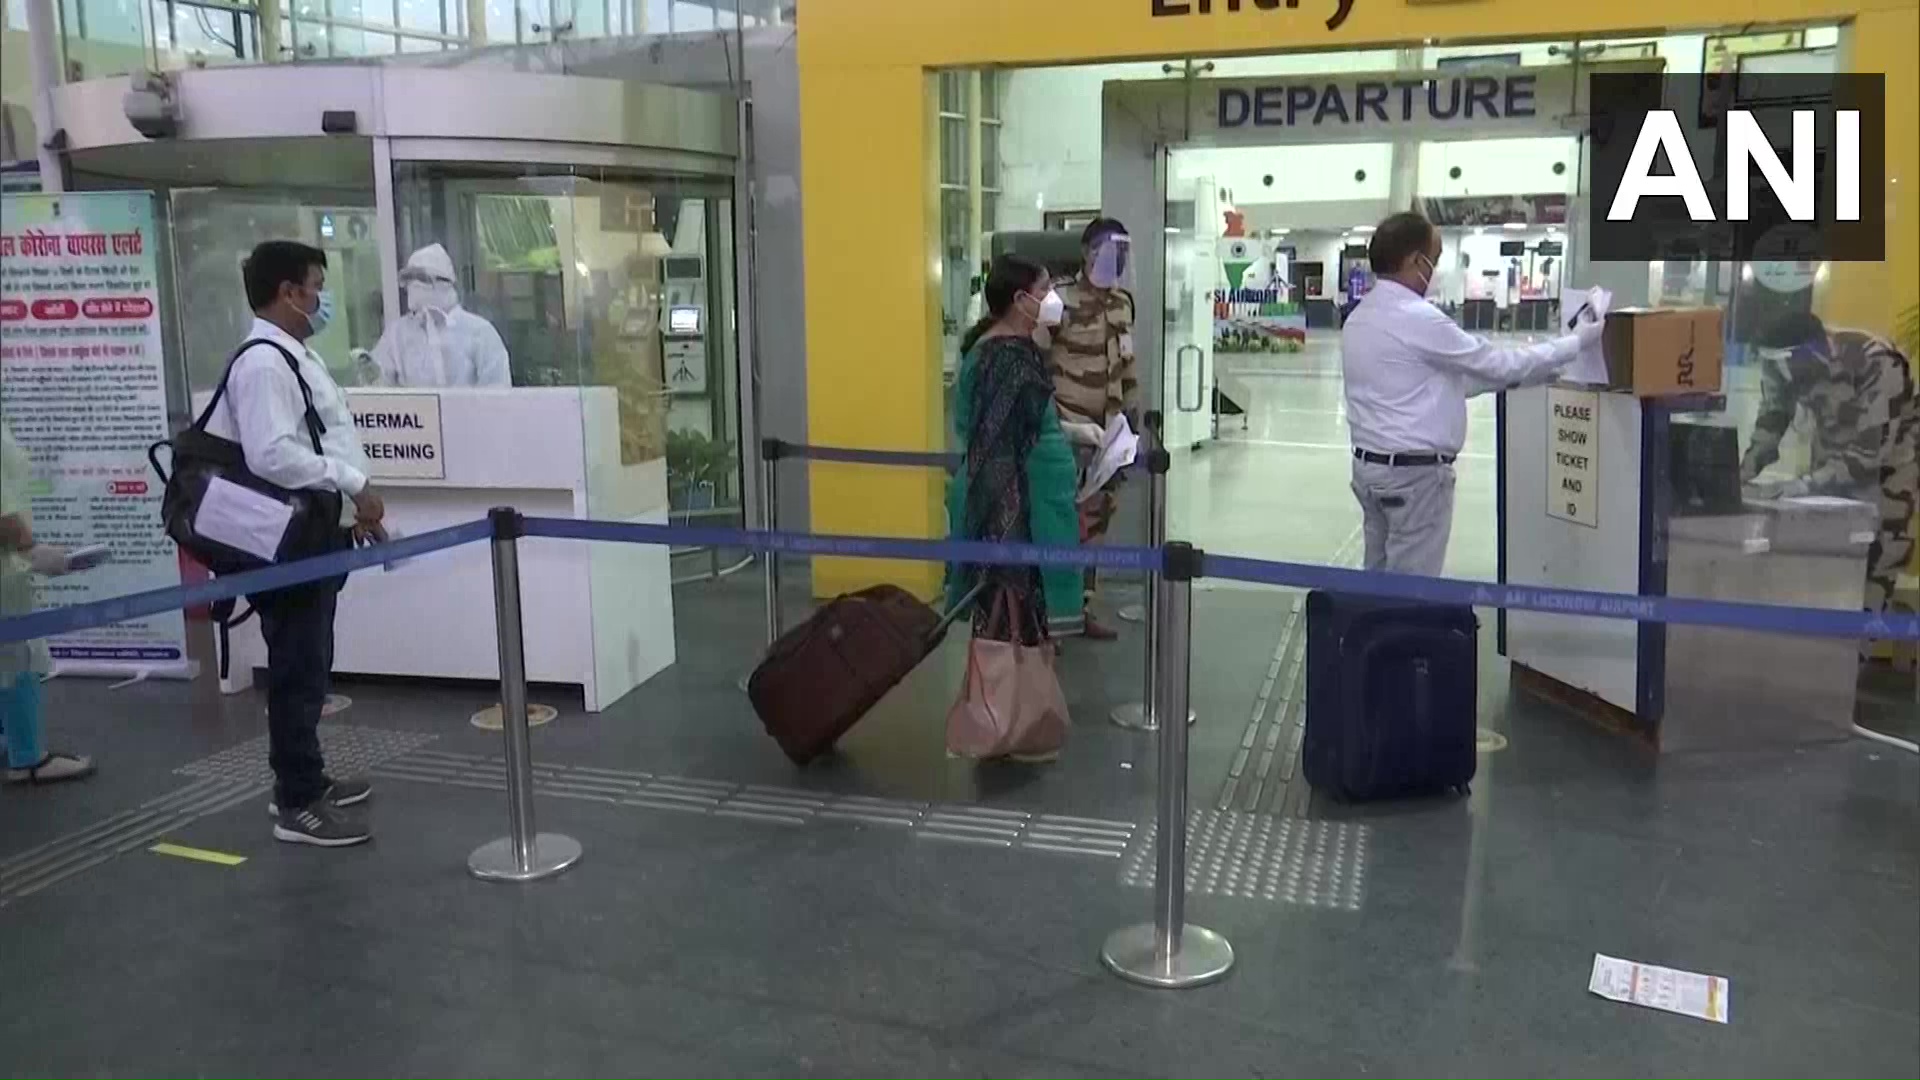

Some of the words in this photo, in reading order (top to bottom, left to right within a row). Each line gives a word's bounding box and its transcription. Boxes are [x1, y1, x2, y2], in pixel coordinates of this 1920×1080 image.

[1218, 75, 1537, 128] DEPARTURE
[18, 229, 61, 256] कोरोना
[65, 234, 107, 256] वायरस
[1214, 289, 1226, 303] SI
[353, 413, 424, 429] HERMAL
[1554, 403, 1591, 422] PLEASE
[1558, 428, 1588, 445] SHOW
[362, 443, 435, 460] REENING
[1556, 452, 1588, 471] TICKET
[1562, 477, 1582, 493] AND
[1566, 502, 1577, 517] ID
[1532, 593, 1597, 610] LUCKNOW
[1600, 598, 1655, 616] AIRPORT
